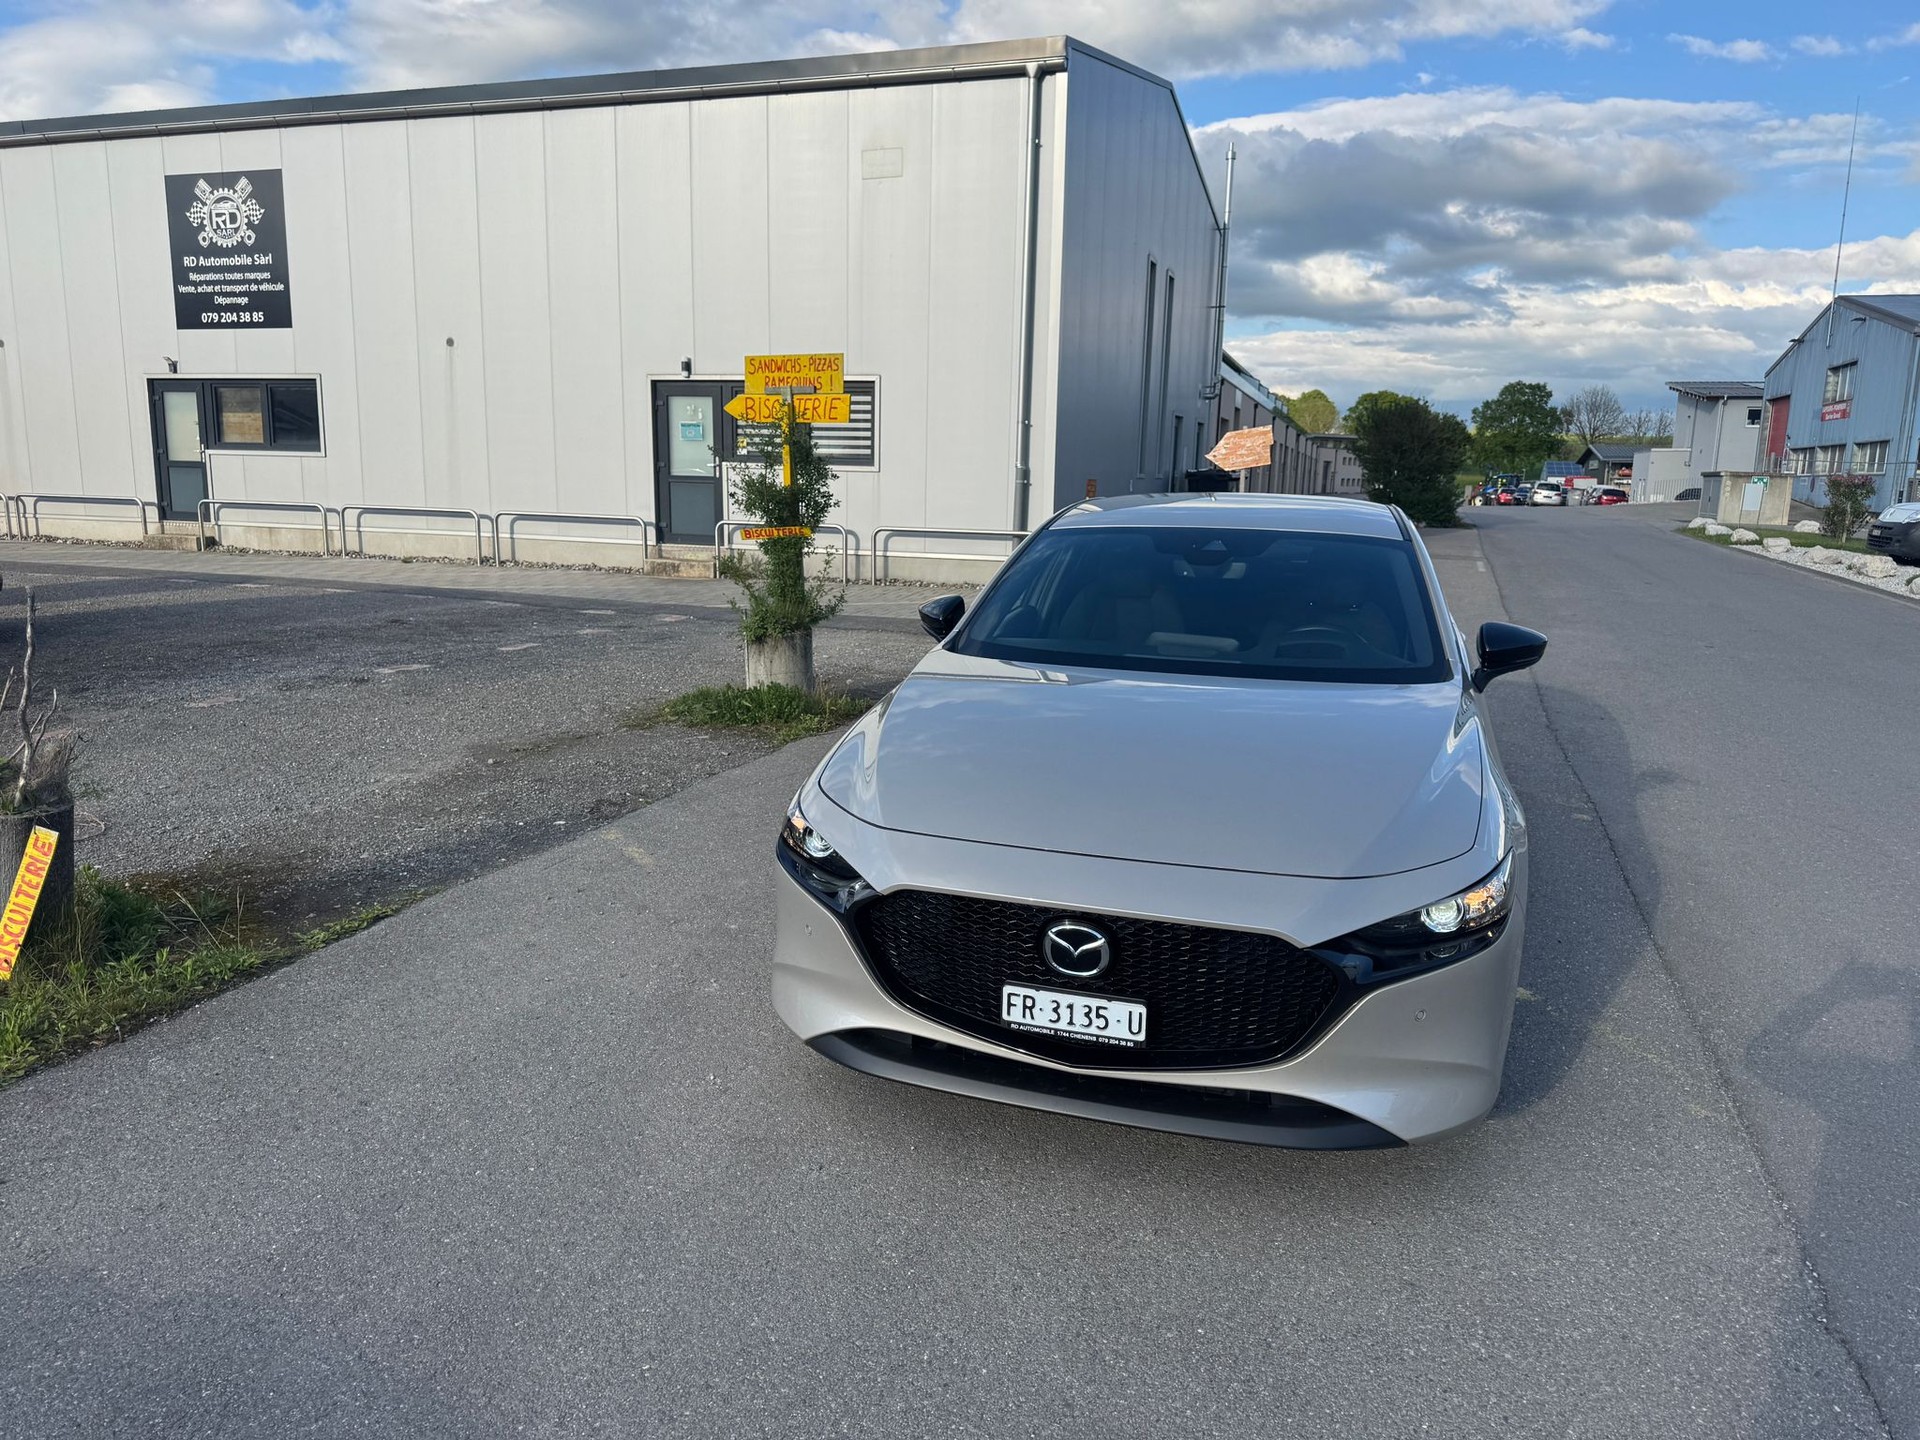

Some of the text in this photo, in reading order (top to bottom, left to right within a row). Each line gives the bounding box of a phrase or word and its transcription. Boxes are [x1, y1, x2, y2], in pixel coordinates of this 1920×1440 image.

[211, 209, 241, 229] RD
[184, 253, 272, 267] RD Automobile Sàrl
[189, 272, 271, 283] Réparations toutes marques
[178, 282, 284, 294] Vente, achat et transport de véhicule
[214, 296, 249, 306] Dépannage
[201, 312, 264, 323] 079 204 38 85
[748, 356, 801, 375] SANDWICHS
[808, 354, 840, 373] PIZZAS
[745, 397, 841, 421] BISCTERIE
[744, 527, 805, 539] BISCUITERIE
[1006, 992, 1143, 1036] FR 3135 U
[1019, 1024, 1055, 1036] AUTOMOBILE
[1070, 1032, 1097, 1042] CHENENS
